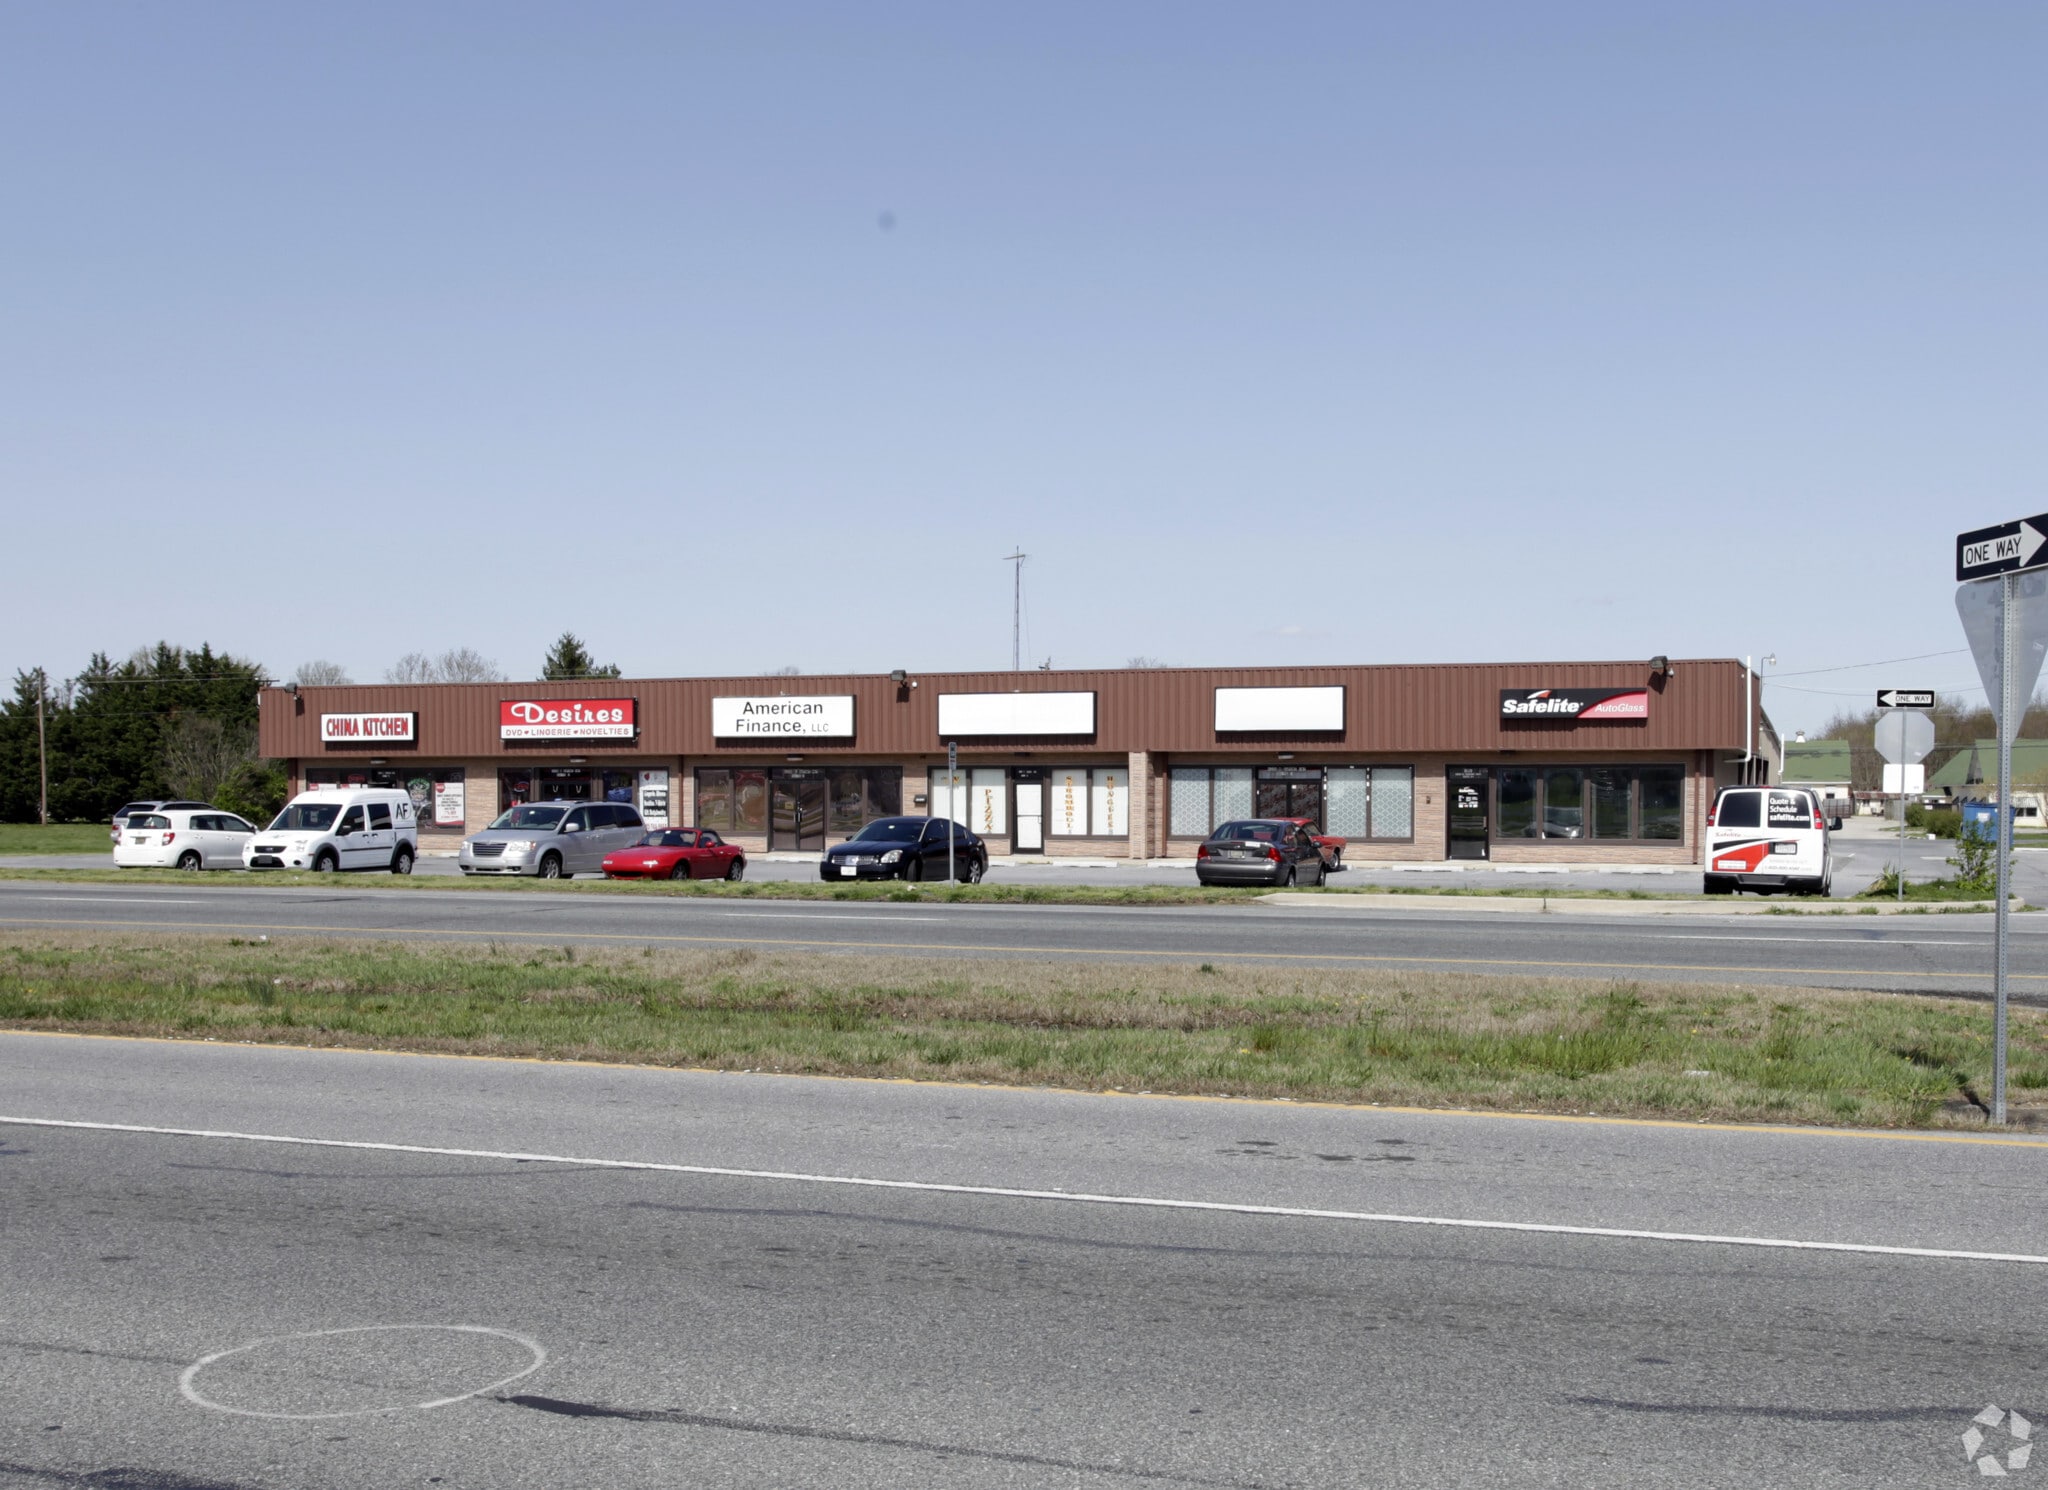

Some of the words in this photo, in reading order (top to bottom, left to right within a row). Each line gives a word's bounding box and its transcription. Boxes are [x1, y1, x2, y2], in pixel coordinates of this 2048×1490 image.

[1965, 544, 1989, 565] ONE
[1996, 536, 2022, 558] WAY
[510, 702, 623, 723] Desires
[743, 701, 823, 715] American
[1502, 698, 1579, 713] Safelite
[1595, 703, 1645, 713] AutoGlass
[326, 717, 360, 737] CHINA
[363, 717, 409, 736] KITCHEN
[505, 728, 523, 736] DVD
[531, 728, 571, 736] LINGERIE
[580, 727, 629, 736] NOVELTIES
[735, 719, 806, 735] Finance,
[811, 723, 829, 733] LLC
[395, 803, 409, 820] AF
[984, 788, 993, 831] PIZZA
